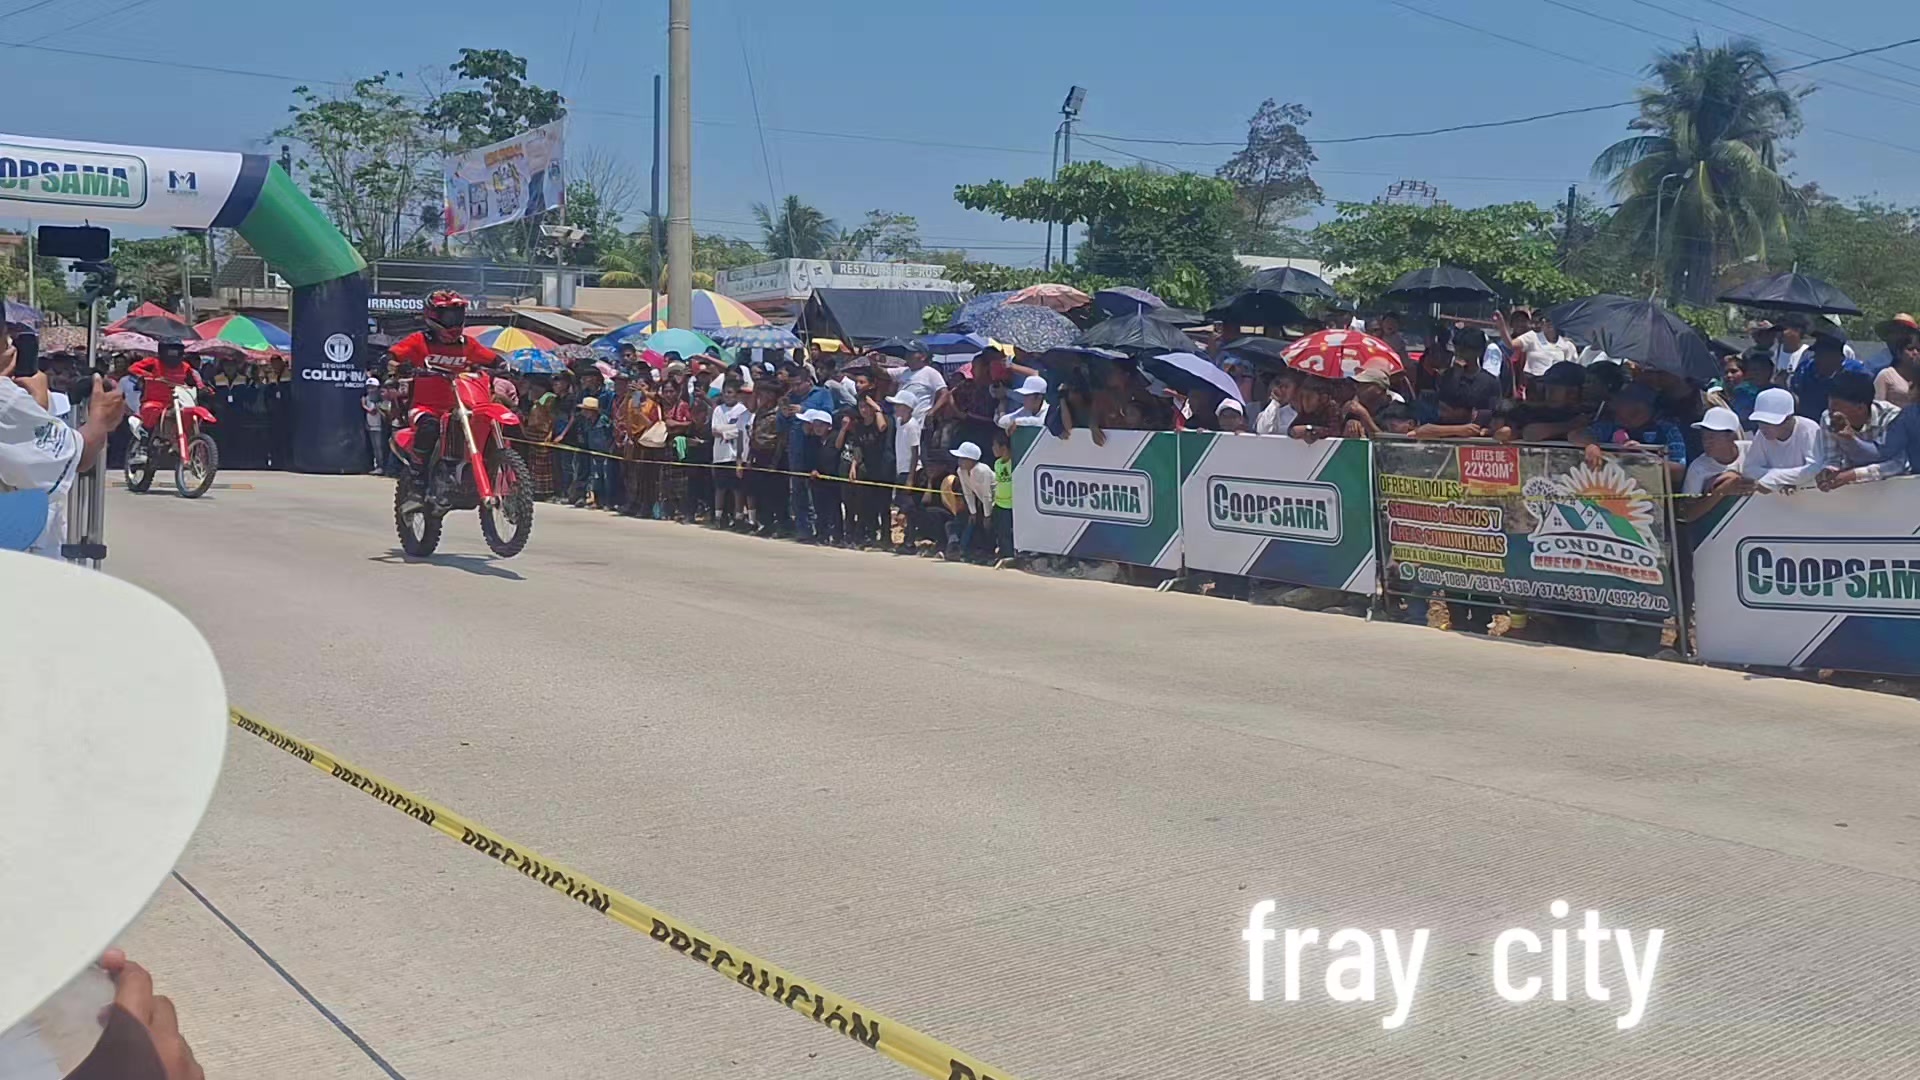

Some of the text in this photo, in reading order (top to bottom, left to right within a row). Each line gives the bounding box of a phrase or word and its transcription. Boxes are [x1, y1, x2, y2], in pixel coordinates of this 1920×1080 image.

[1471, 449, 1506, 461] LOTES DE
[1039, 471, 1142, 514] COOPSAMA
[1213, 483, 1329, 531] COOPSAMA
[1490, 509, 1499, 528] Y
[1424, 529, 1505, 553] COMUNITARIAS
[1536, 538, 1655, 568] CONDADO
